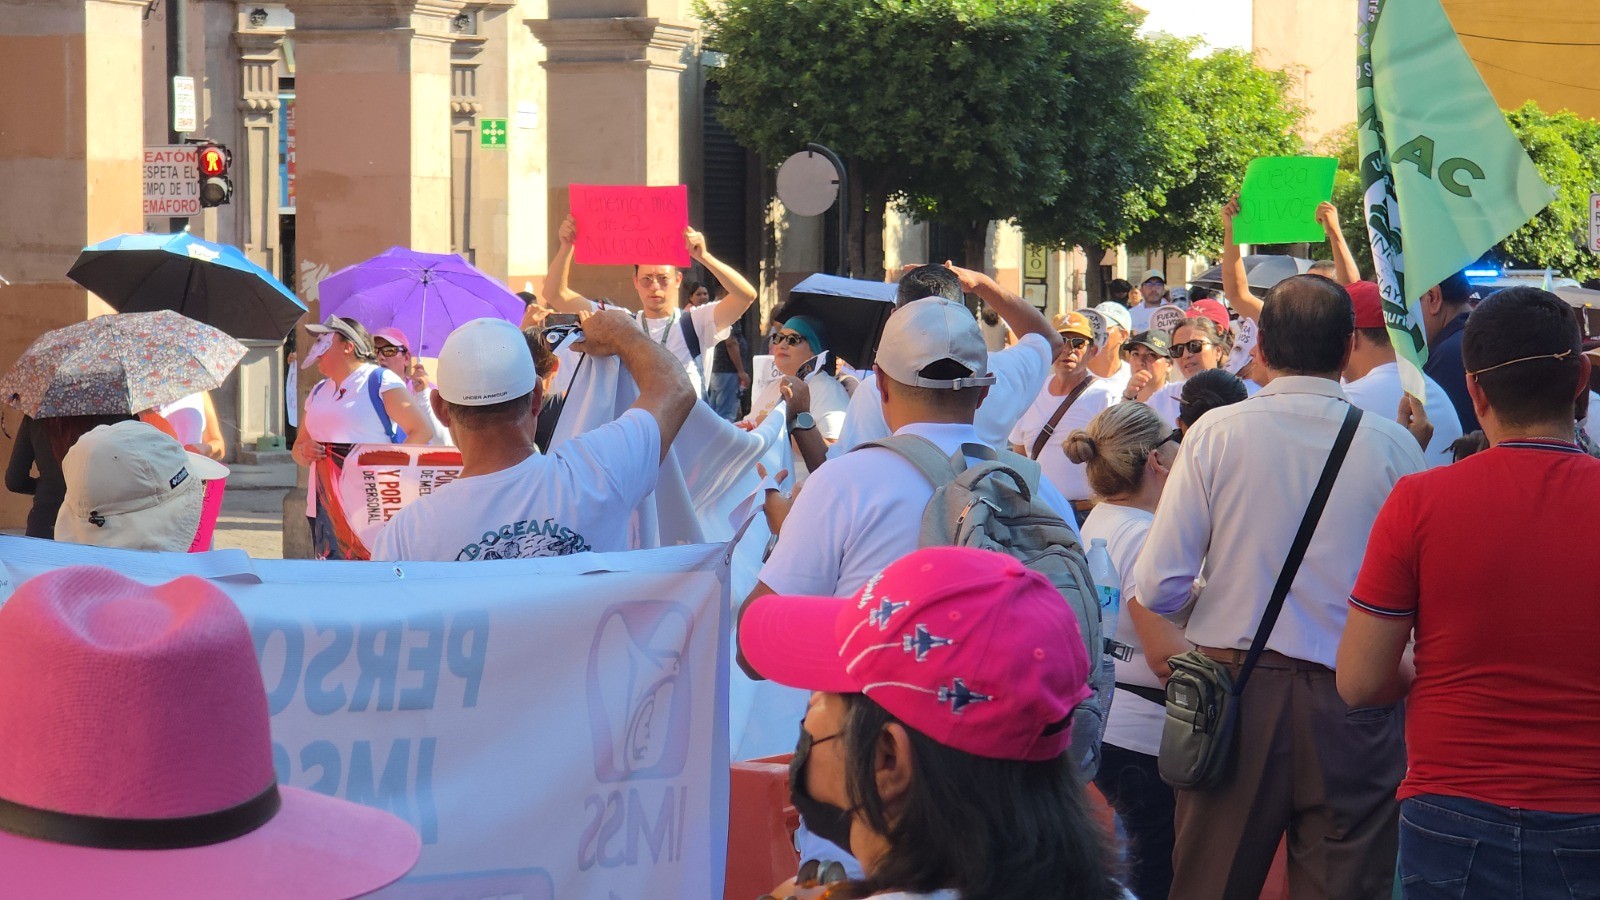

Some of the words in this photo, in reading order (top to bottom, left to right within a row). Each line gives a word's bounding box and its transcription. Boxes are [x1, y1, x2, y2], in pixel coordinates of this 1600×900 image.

[184, 165, 196, 179] EL
[170, 182, 182, 195] DE
[186, 182, 197, 195] TU
[1156, 312, 1179, 321] FUERA
[482, 391, 508, 400] ARMOUR
[362, 470, 375, 481] DE
[377, 468, 401, 478] Y
[420, 469, 434, 479] DE
[378, 481, 402, 505] POR
